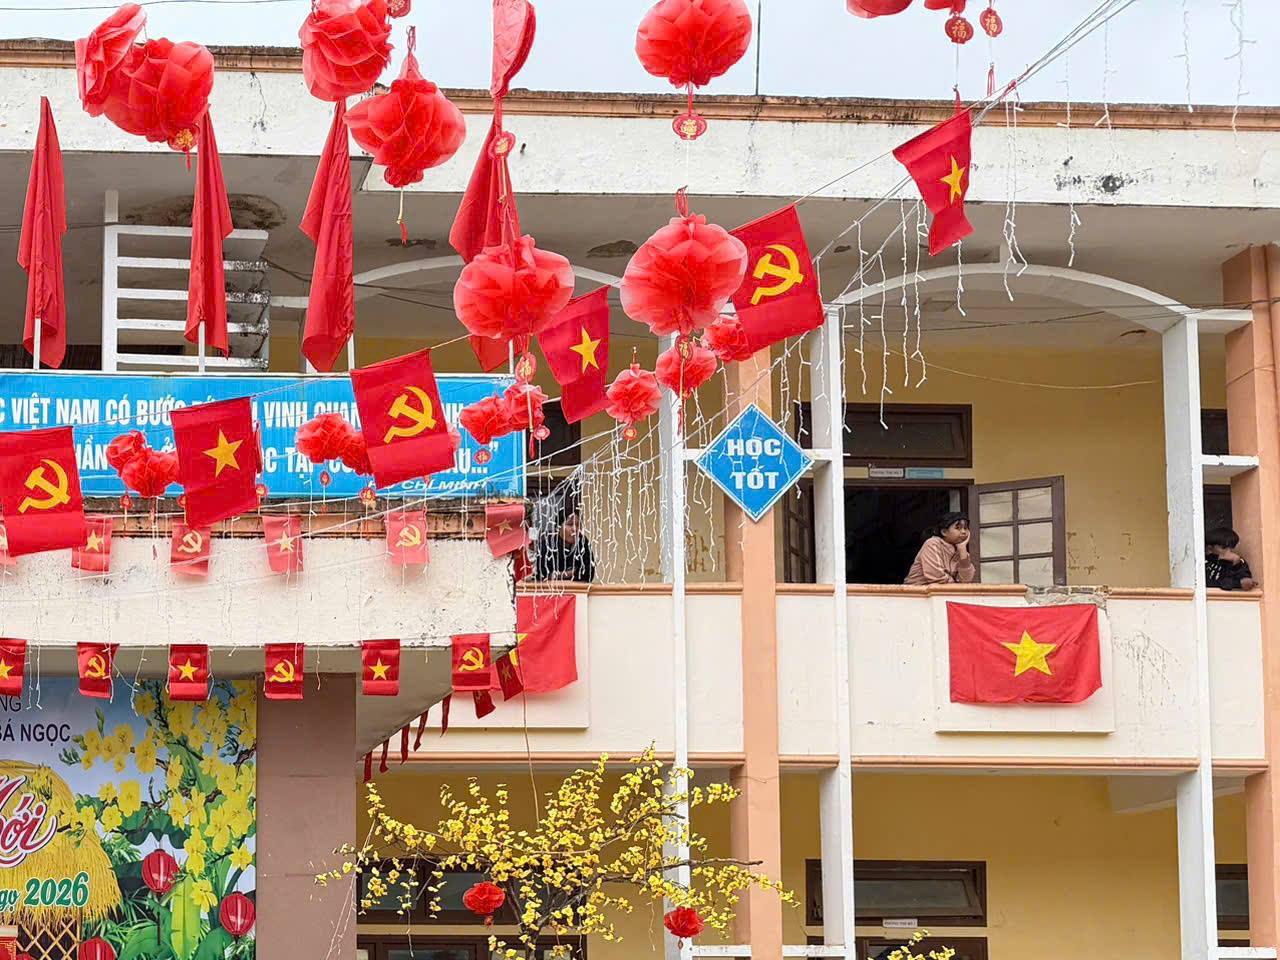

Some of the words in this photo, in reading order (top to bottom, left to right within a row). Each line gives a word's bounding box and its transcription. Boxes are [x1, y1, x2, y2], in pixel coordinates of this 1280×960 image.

[12, 392, 50, 429] VIỆT
[56, 398, 99, 425] NAM
[105, 394, 132, 426] CÓ
[264, 401, 308, 428] VINH
[727, 438, 781, 459] HỌC
[732, 465, 780, 490] TỐT
[20, 723, 71, 747] NGỌC
[23, 872, 90, 907] 2026
